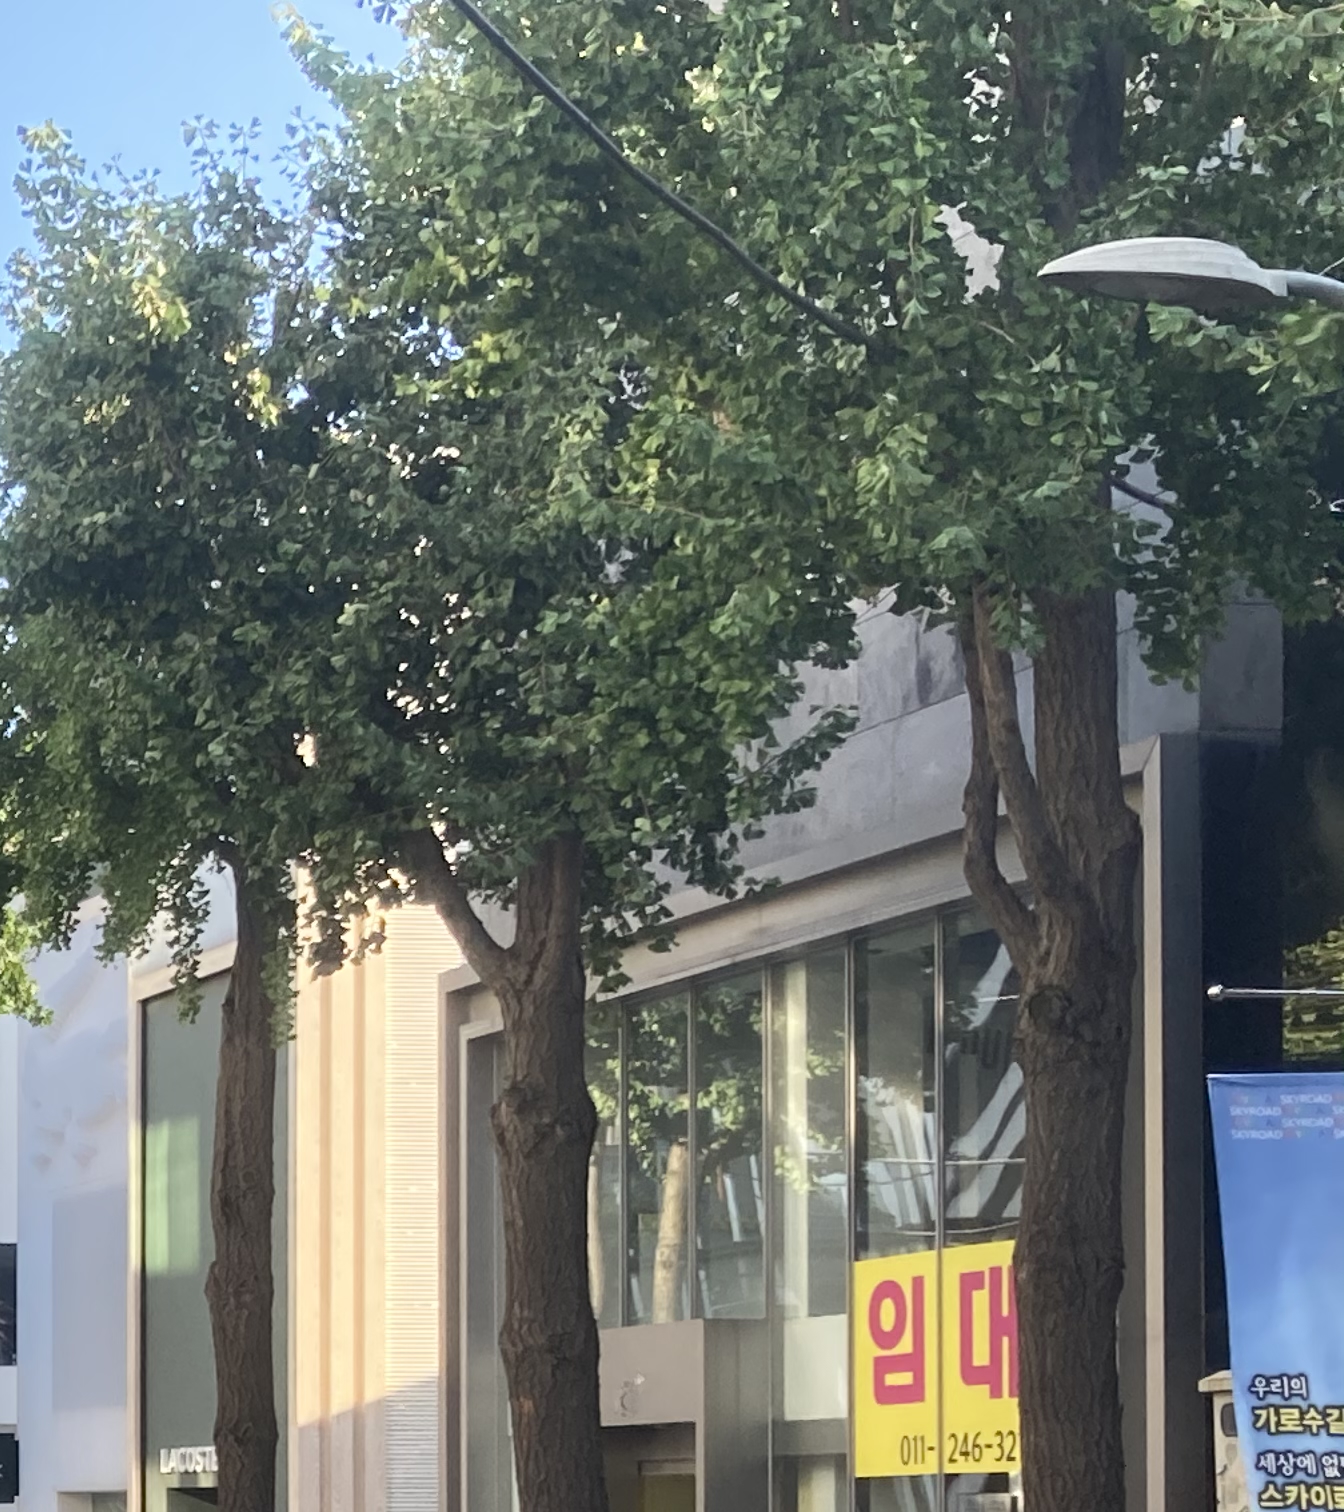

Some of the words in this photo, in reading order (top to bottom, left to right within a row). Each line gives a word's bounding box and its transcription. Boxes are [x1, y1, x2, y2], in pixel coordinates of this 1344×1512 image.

[1250, 1376, 1308, 1399] 우리의
[159, 1446, 218, 1473] LACOSTE
[1257, 1452, 1317, 1477] 세상에
[1259, 1483, 1344, 1511] 스카이로
